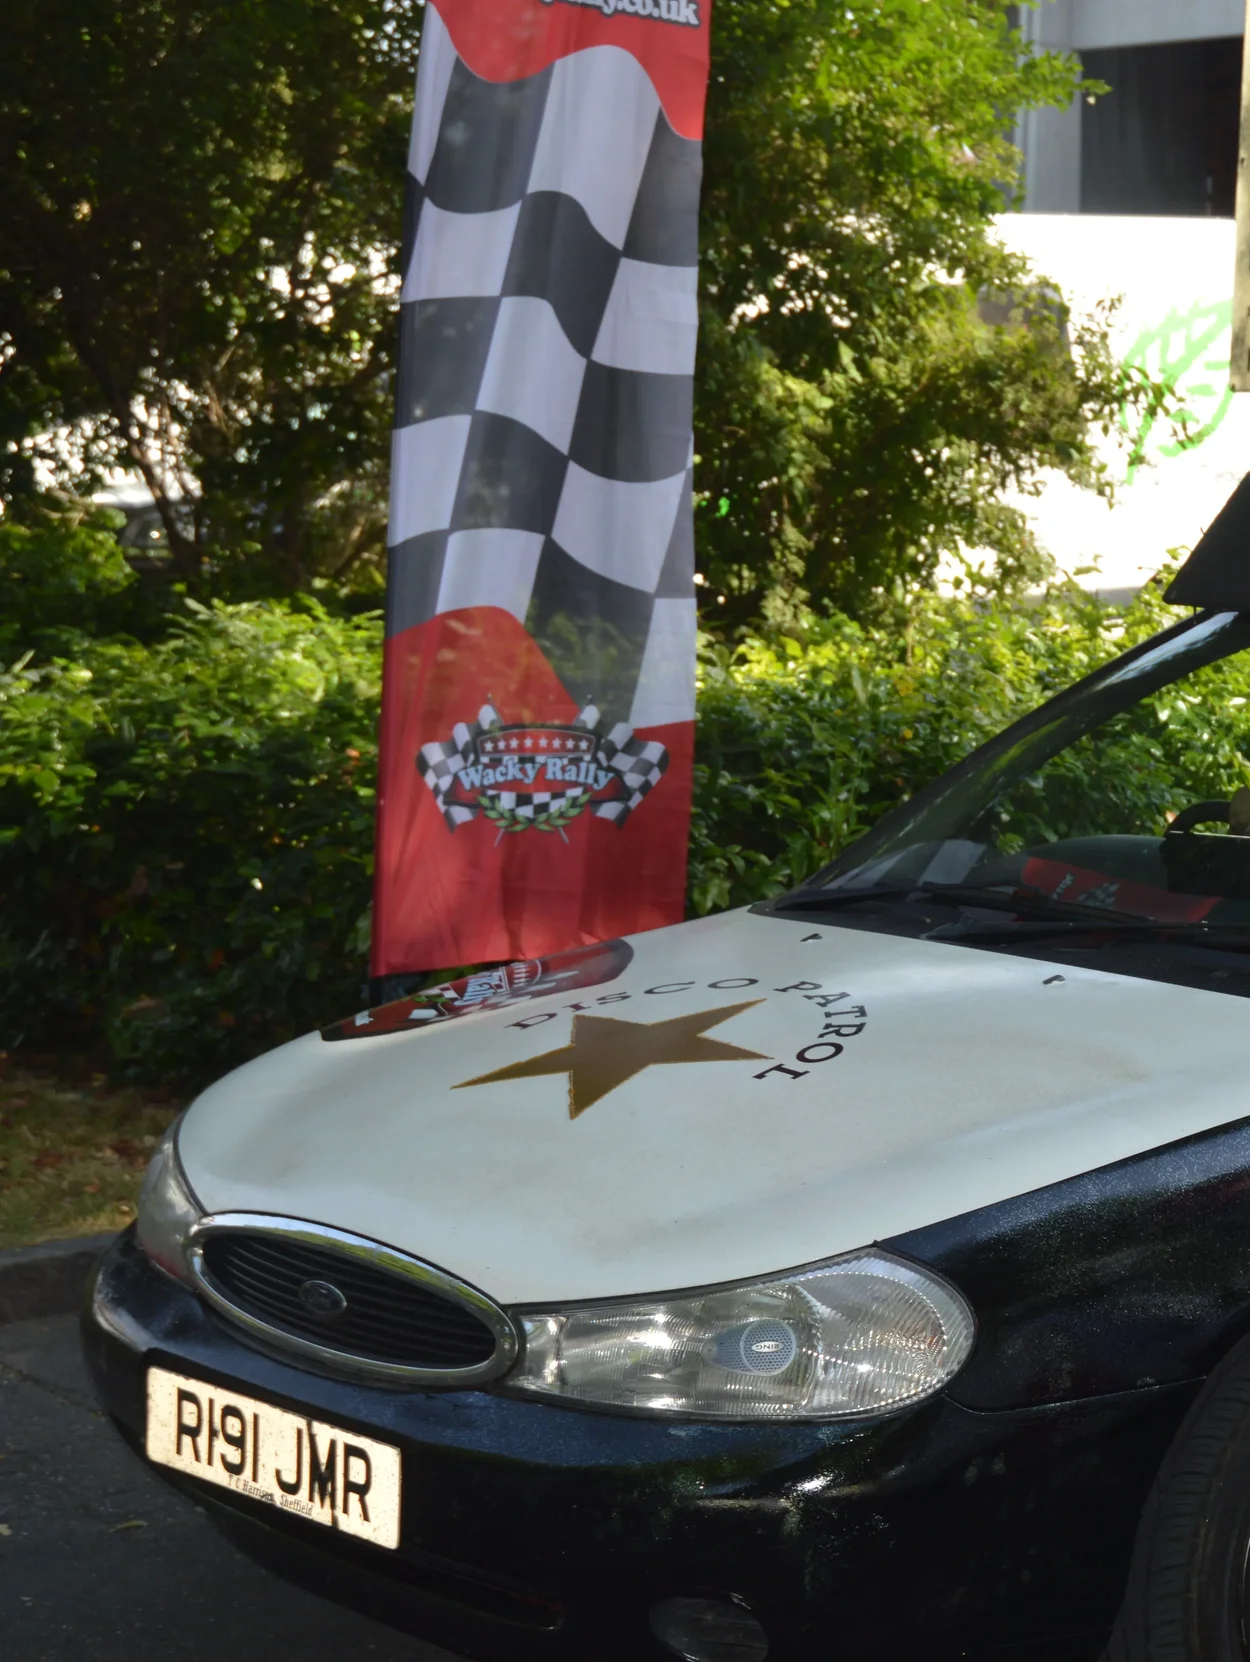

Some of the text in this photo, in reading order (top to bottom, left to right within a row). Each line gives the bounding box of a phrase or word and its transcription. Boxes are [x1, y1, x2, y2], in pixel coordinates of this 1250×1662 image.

[456, 757, 615, 791] Wacky Rally
[504, 978, 868, 1080] DISCO PATROL
[275, 1426, 372, 1523] JMR
[280, 1494, 314, 1517] Sheffield
